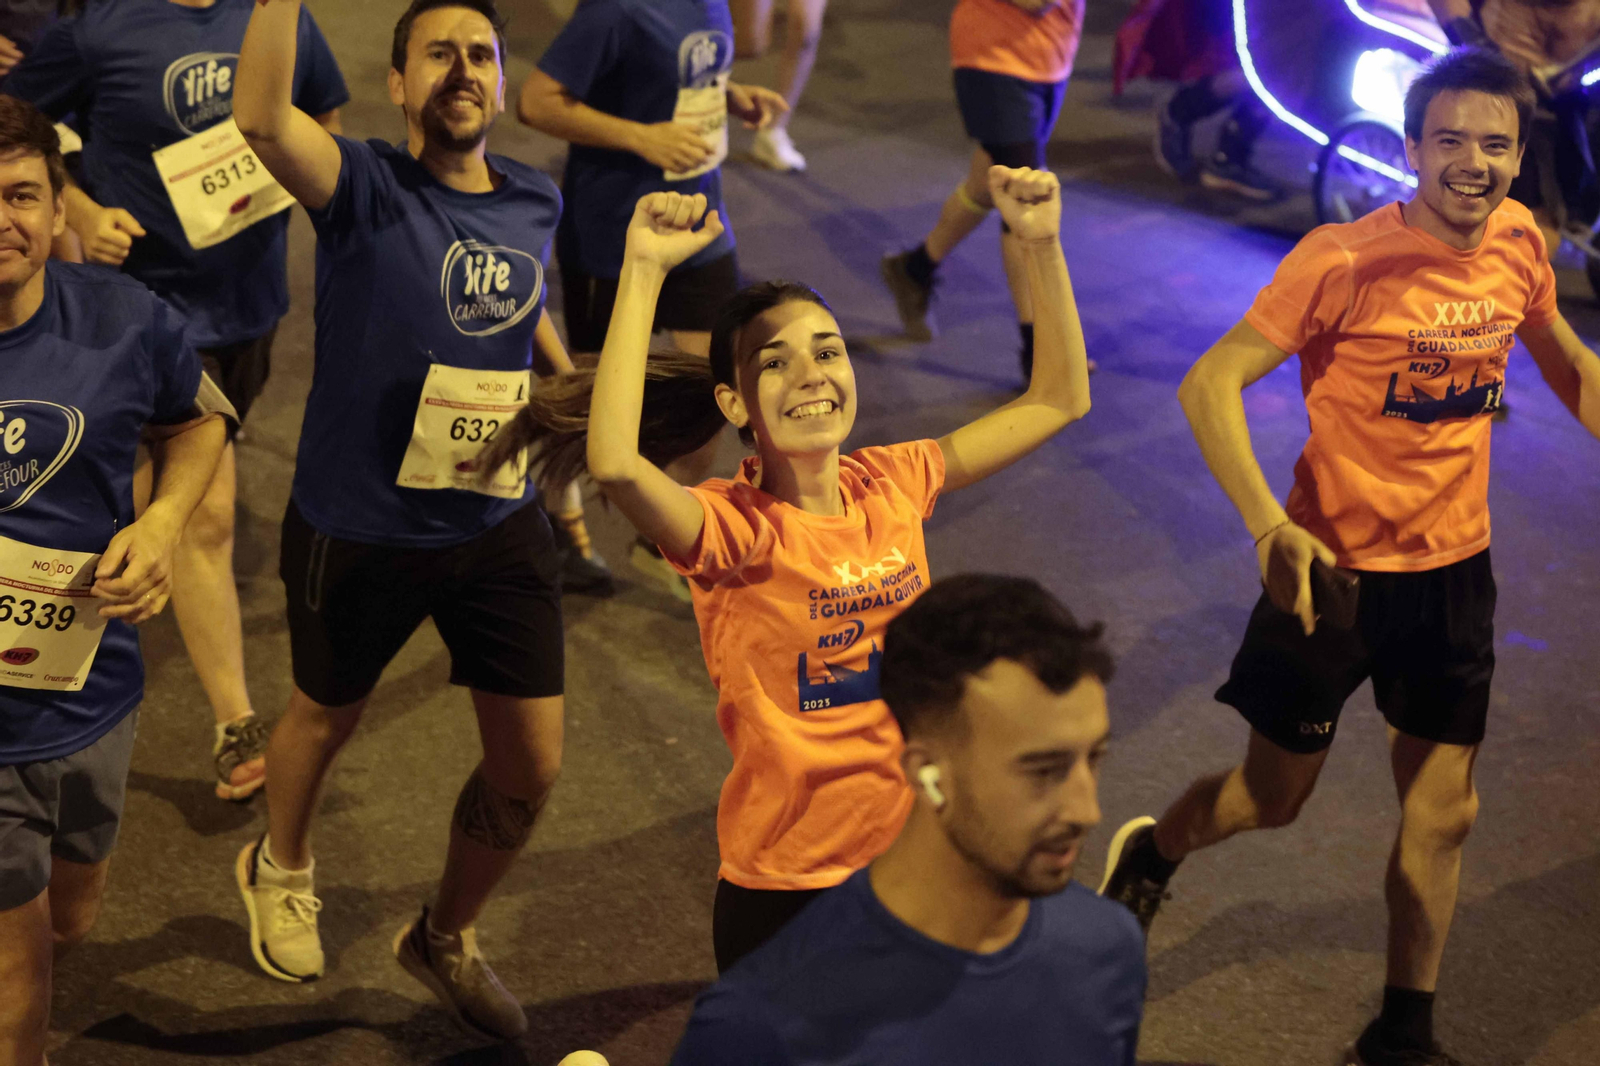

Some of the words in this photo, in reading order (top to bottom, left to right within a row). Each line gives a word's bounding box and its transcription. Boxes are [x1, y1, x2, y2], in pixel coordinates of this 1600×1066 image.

[182, 60, 231, 107] life
[202, 154, 257, 195] 6313
[464, 253, 510, 295] life
[454, 298, 516, 321] CARREFOUR
[1434, 299, 1495, 325] XXXV
[1408, 330, 1457, 339] CARRERA
[1461, 323, 1514, 338] NOCTURNA
[1417, 333, 1514, 353] GUADALQUIVIR
[1407, 340, 1415, 353] DEL
[450, 417, 499, 443] 632
[808, 581, 877, 600] CARRERA
[821, 575, 924, 618] GUADALQUIVIR
[0, 595, 76, 632] 6339
[803, 698, 831, 710] 2023
